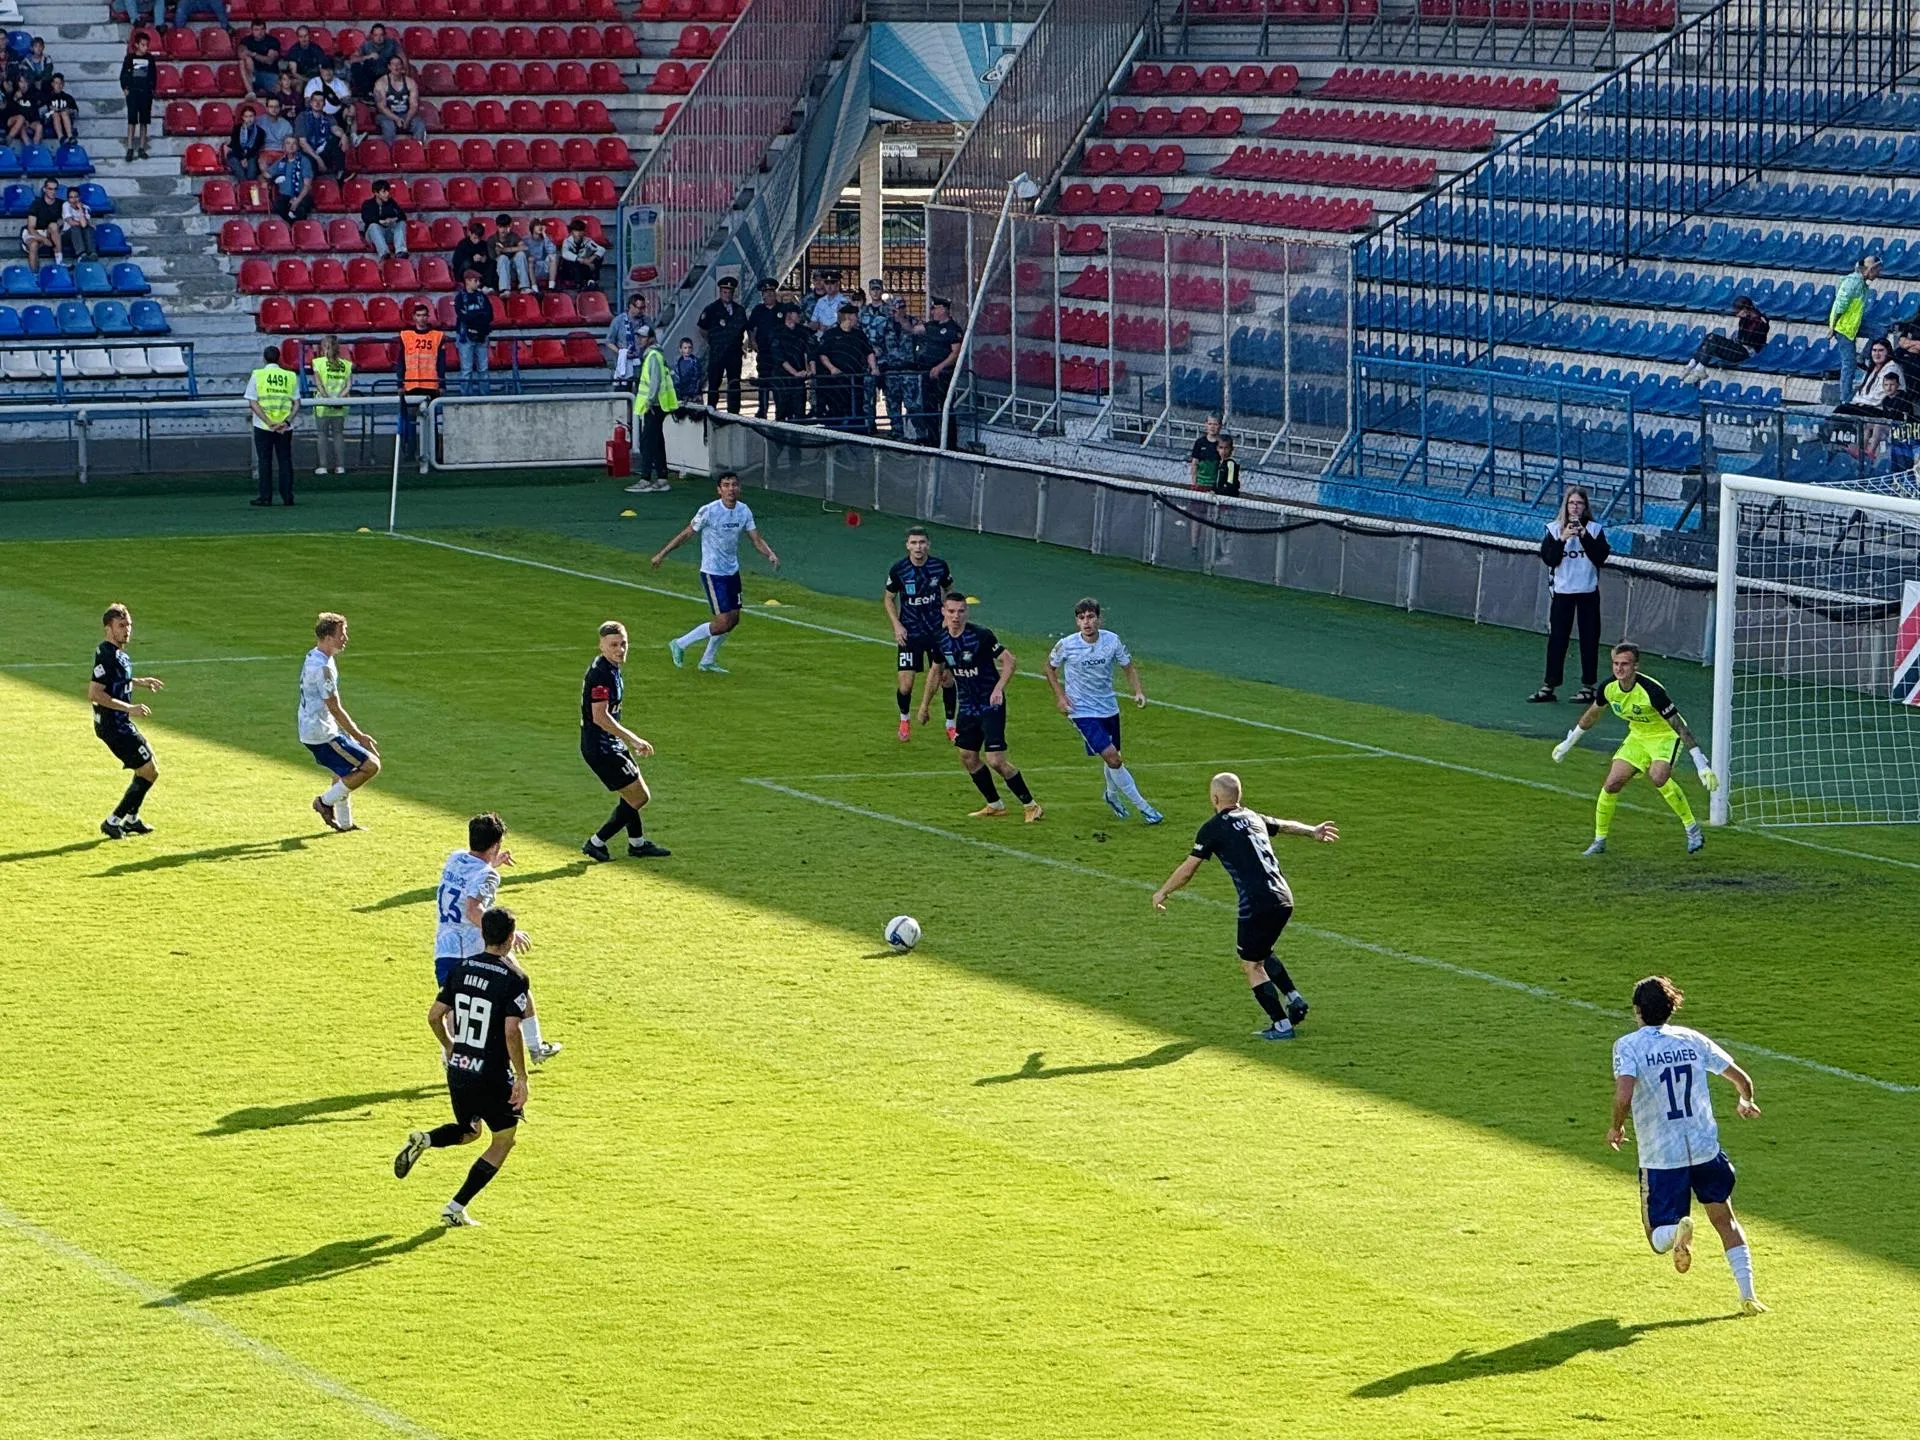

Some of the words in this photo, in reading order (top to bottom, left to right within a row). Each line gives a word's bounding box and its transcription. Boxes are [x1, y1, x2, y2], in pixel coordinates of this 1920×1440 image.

[415, 338, 432, 350] 235
[266, 374, 288, 387] 4491
[899, 652, 913, 667] 24
[138, 744, 150, 760] 9
[438, 883, 462, 924] 13
[1645, 1048, 1698, 1067] НАБИЕВ
[1659, 1063, 1694, 1121] 17
